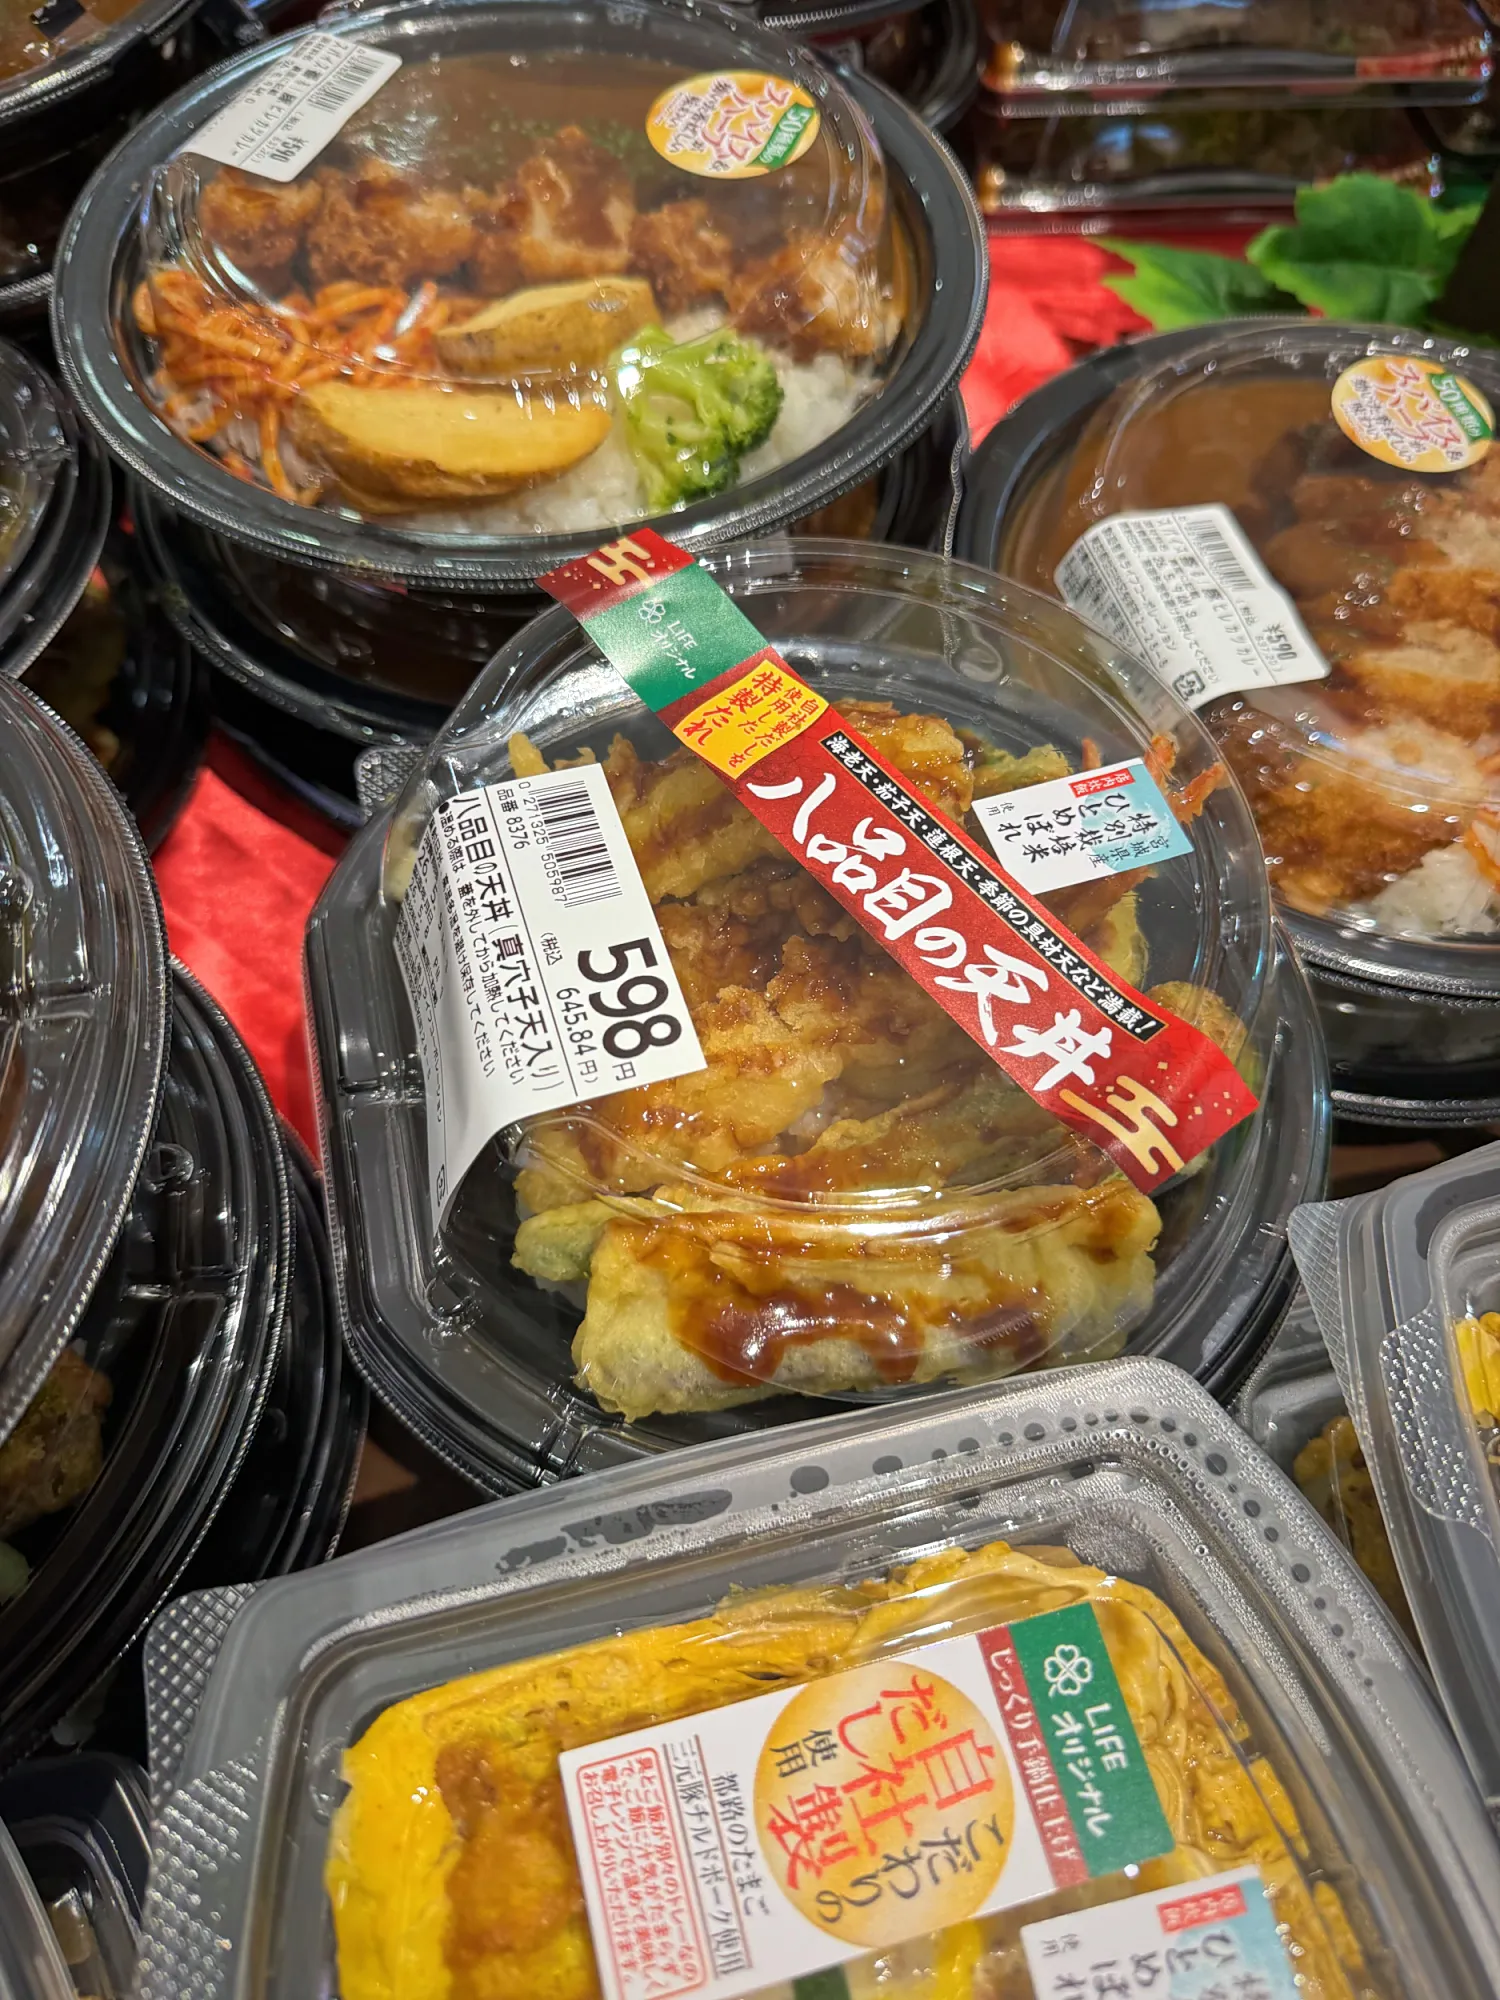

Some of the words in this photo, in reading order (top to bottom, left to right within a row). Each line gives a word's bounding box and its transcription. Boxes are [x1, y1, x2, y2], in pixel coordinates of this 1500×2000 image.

[270, 136, 309, 164] ¥590
[651, 630, 695, 679] オリジナル
[667, 620, 698, 650] LIFE
[1264, 623, 1297, 662] ¥590
[683, 671, 783, 746] 特製だれ
[729, 699, 819, 768] 自社製だしを
[739, 687, 802, 734] 使用した
[497, 789, 518, 813] 品番
[1074, 772, 1131, 795] 店内炊飯
[506, 817, 530, 849] 8376
[986, 802, 1011, 816] 使用
[998, 793, 1130, 843] ひとめぼれ
[522, 797, 546, 844] 271325
[541, 853, 567, 902] 505987
[1022, 813, 1158, 863] 特別栽培米
[1087, 836, 1169, 868] 宮城県産
[453, 795, 565, 1091] 八品目の天丼(真穴子天入り)
[746, 773, 1111, 1091] 八品目の天丼
[1084, 1702, 1129, 1773] LIFE
[1051, 1711, 1113, 1838] オリジナル
[767, 1728, 996, 1891] 自社製
[711, 1773, 770, 1916] 都路のたまご
[816, 1814, 1005, 1923] こだわりの
